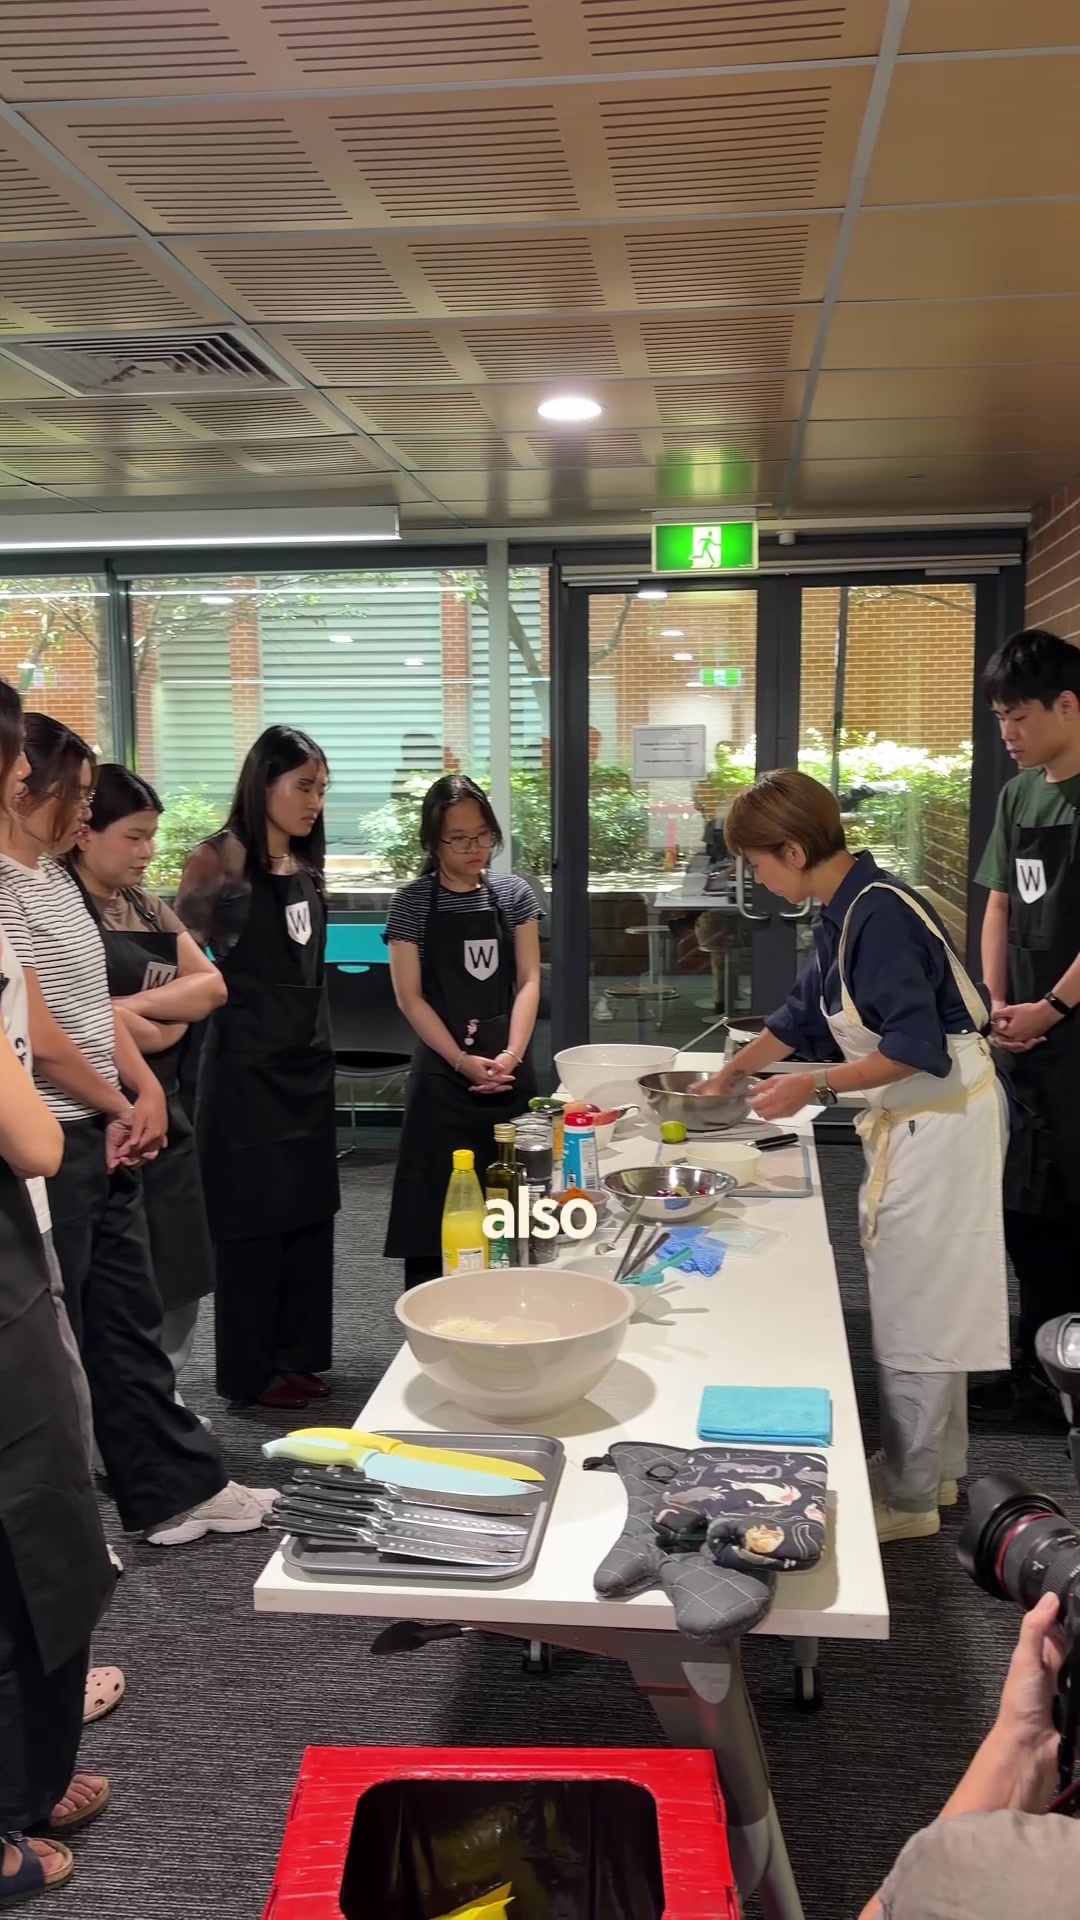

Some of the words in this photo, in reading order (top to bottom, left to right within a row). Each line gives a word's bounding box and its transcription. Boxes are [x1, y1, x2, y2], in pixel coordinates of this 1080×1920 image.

[1020, 865, 1041, 892] W
[289, 908, 307, 934] W
[468, 945, 494, 969] W
[147, 969, 172, 990] W
